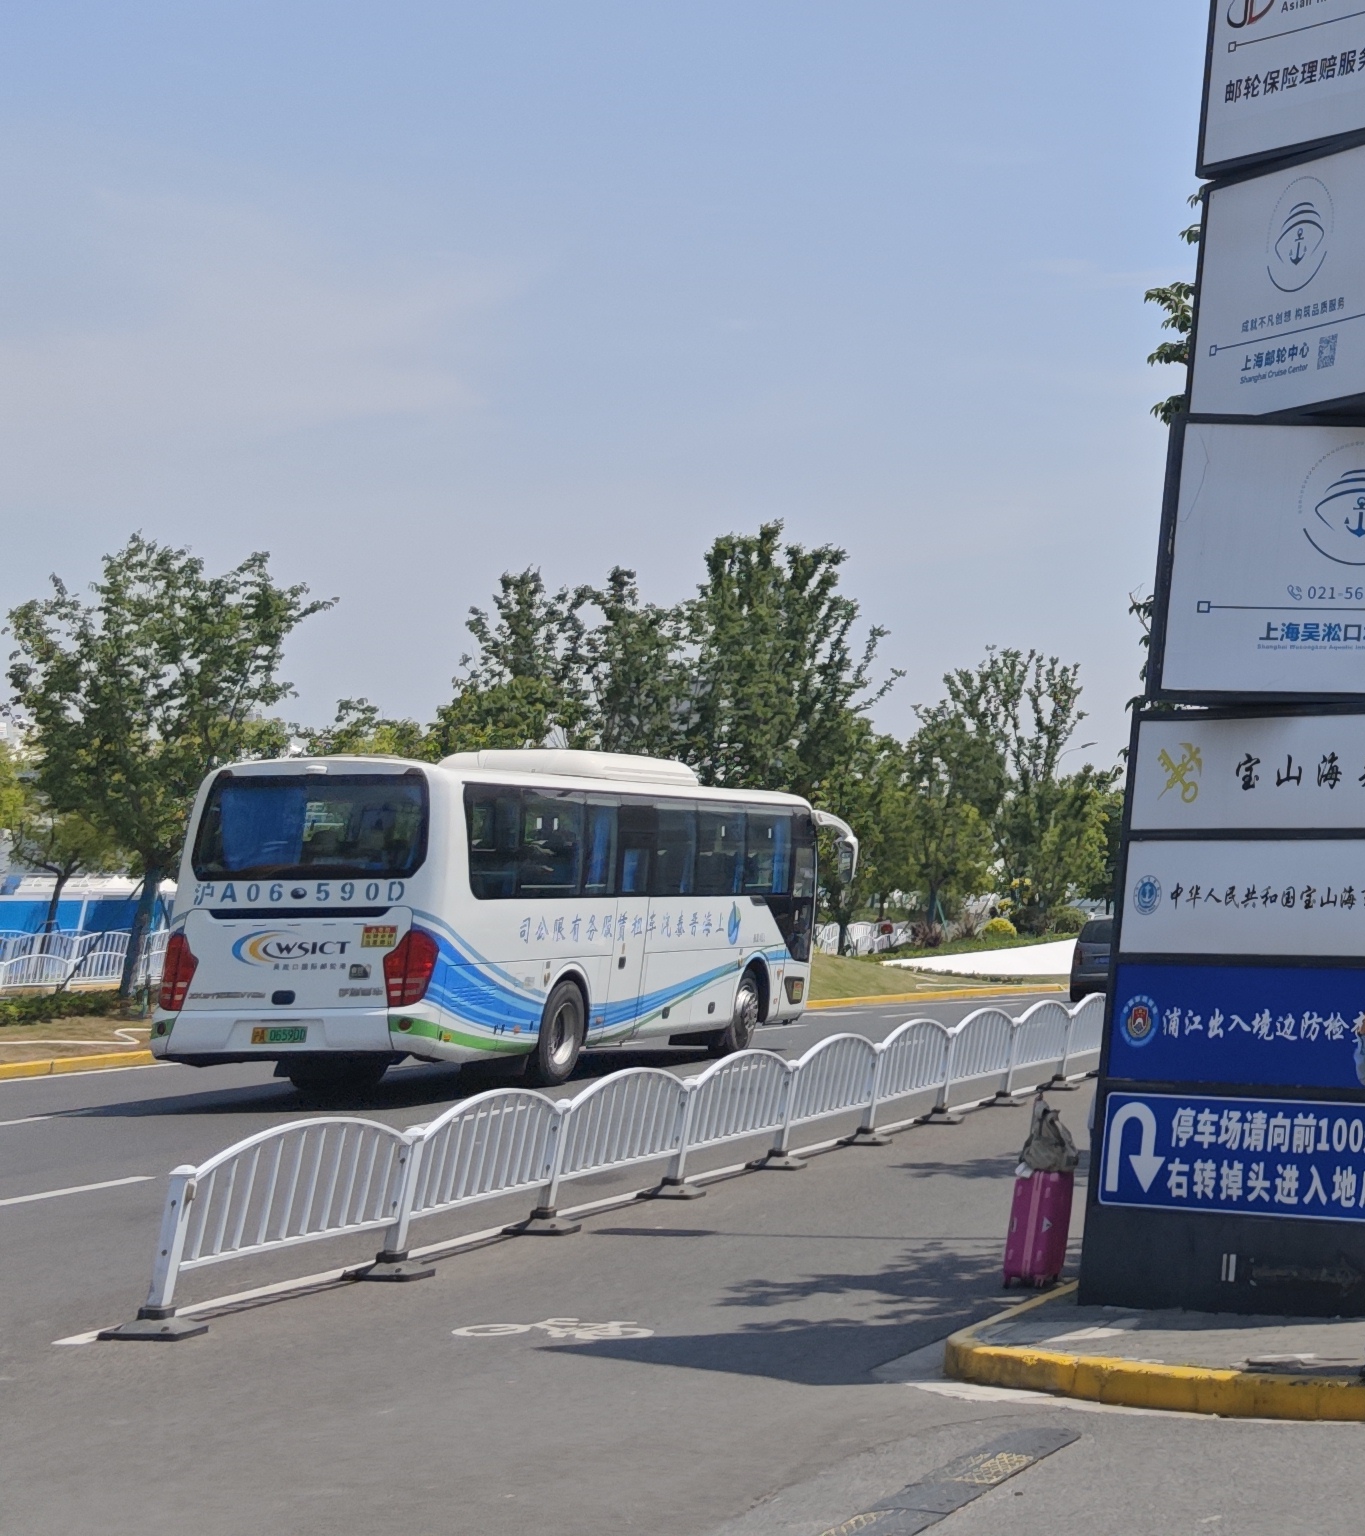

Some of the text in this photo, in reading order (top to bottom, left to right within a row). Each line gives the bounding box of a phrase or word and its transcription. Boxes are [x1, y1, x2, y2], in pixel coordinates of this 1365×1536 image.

[1241, 297, 1345, 333] 成就不凡创想 构筑品质服务
[1241, 342, 1310, 372] 上海邮轮中心
[1240, 371, 1267, 384] Shanghai
[1268, 367, 1287, 379] Cruise
